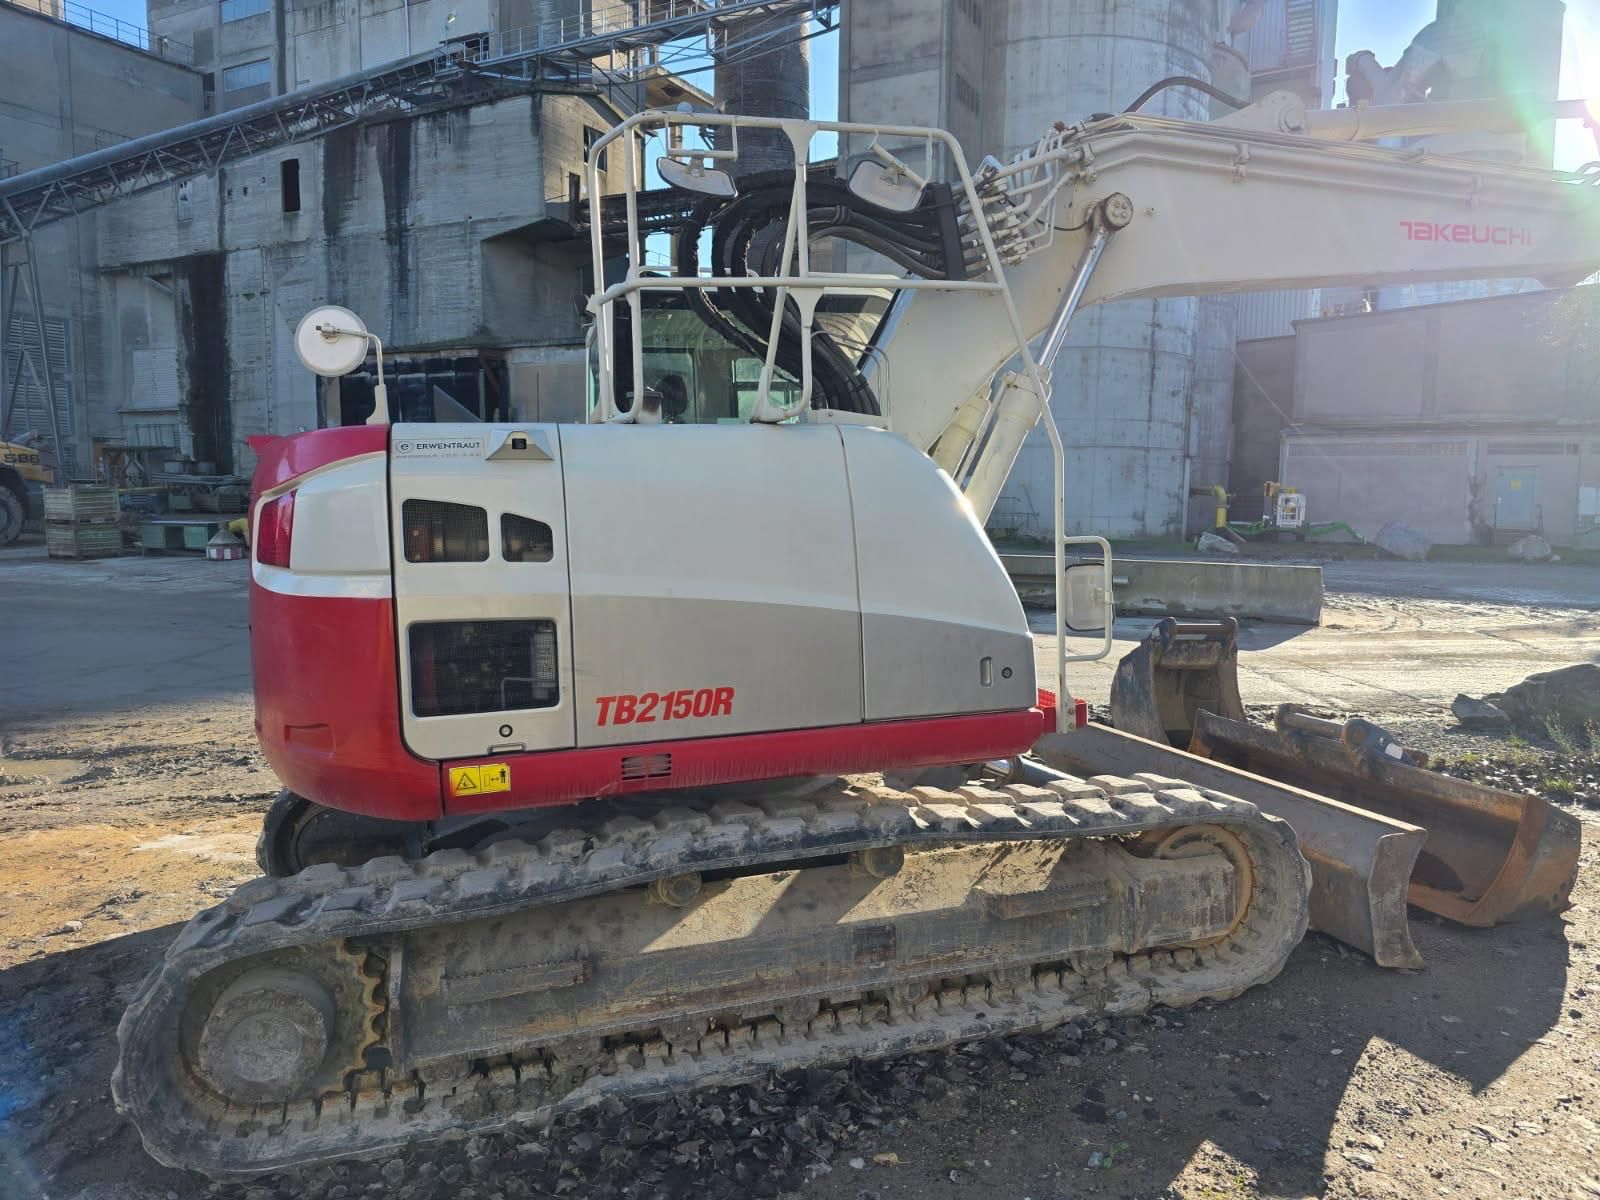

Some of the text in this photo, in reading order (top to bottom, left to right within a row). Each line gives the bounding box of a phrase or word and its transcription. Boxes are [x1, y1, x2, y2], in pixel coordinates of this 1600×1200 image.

[1399, 221, 1532, 246] TAKEUCHI
[416, 442, 481, 450] ERWENTRAUT
[595, 686, 735, 726] TB2150R
